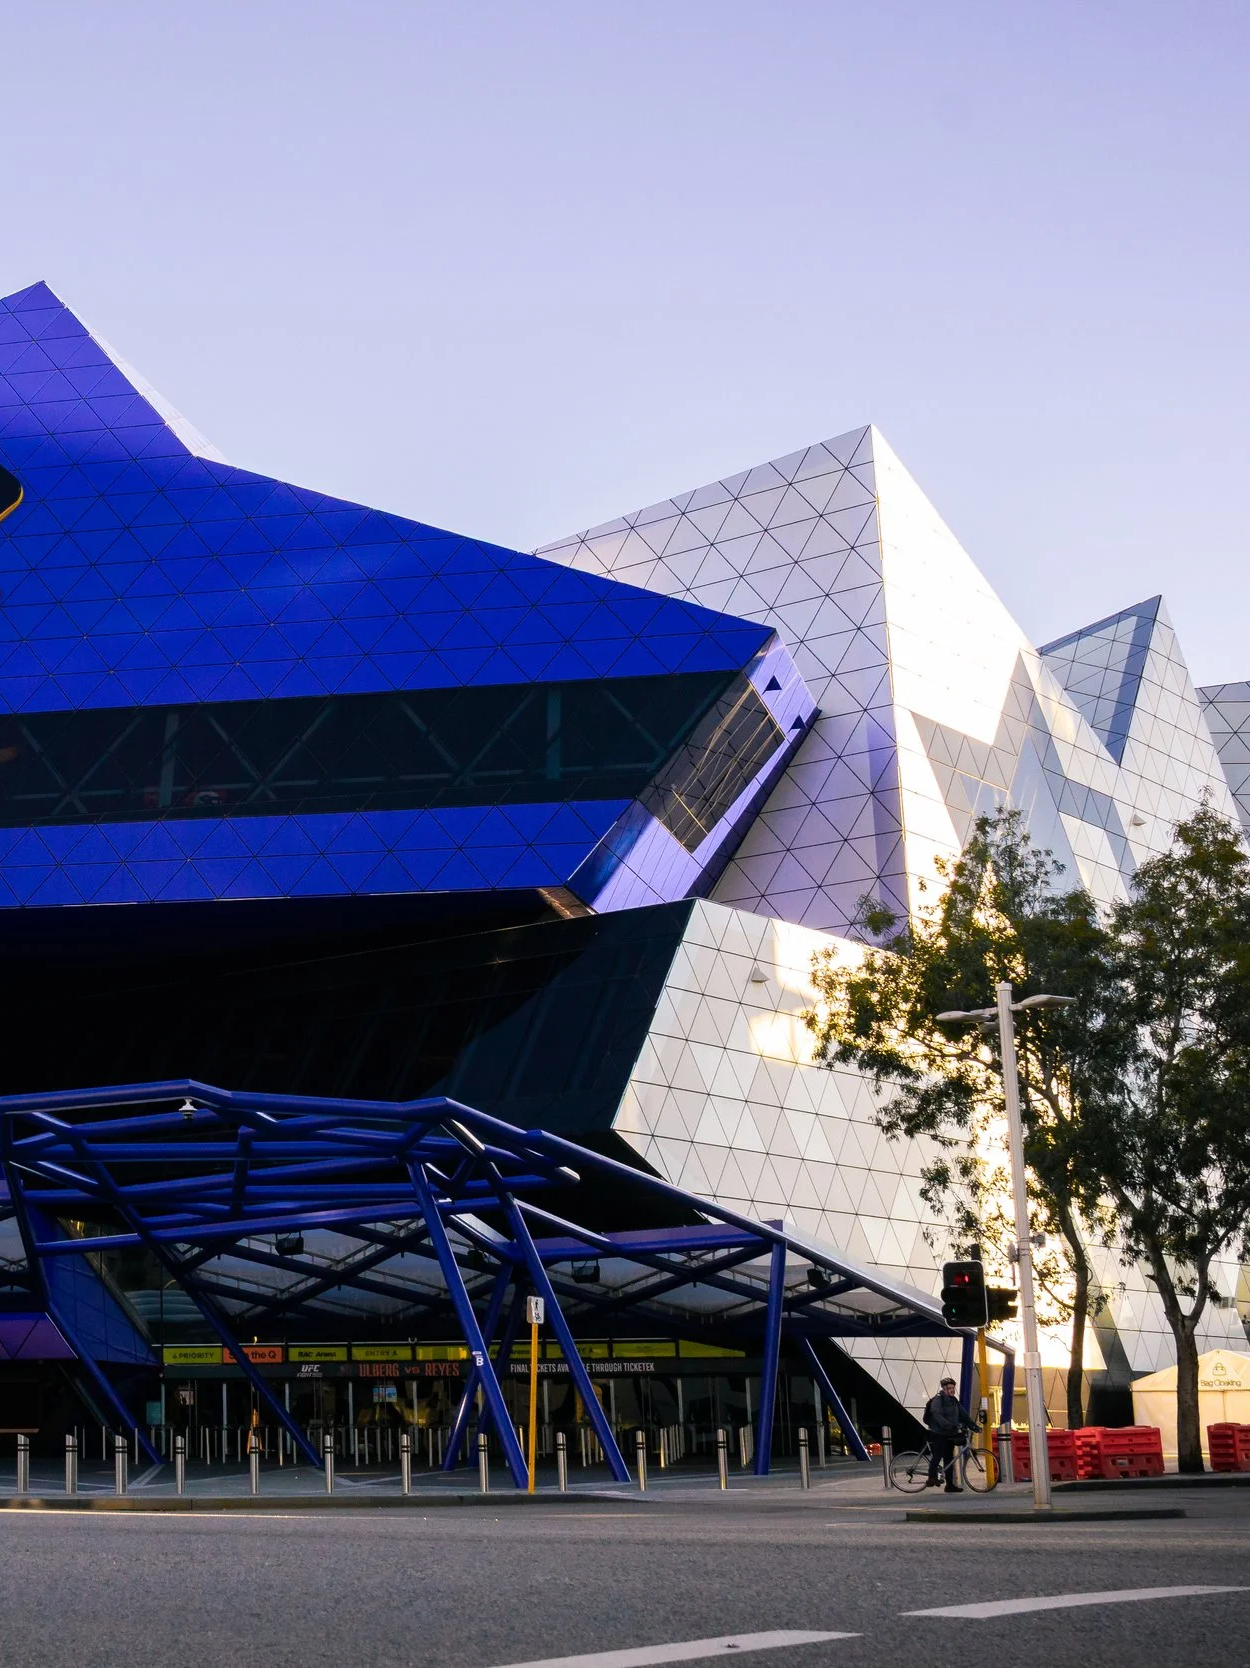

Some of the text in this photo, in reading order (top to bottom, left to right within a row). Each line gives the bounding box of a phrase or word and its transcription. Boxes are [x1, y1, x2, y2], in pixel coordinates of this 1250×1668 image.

[252, 1350, 266, 1359] the
[268, 1350, 278, 1360] Q
[476, 1357, 484, 1366] B
[301, 1364, 321, 1373] UFC
[359, 1363, 400, 1377] ULBERG
[425, 1363, 460, 1377] REYES
[510, 1364, 529, 1373] FINAL
[529, 1363, 557, 1373] CKETS
[591, 1363, 623, 1372] THROUGH
[623, 1362, 655, 1372] TICKETEK
[1214, 1379, 1241, 1387] Cloaking
